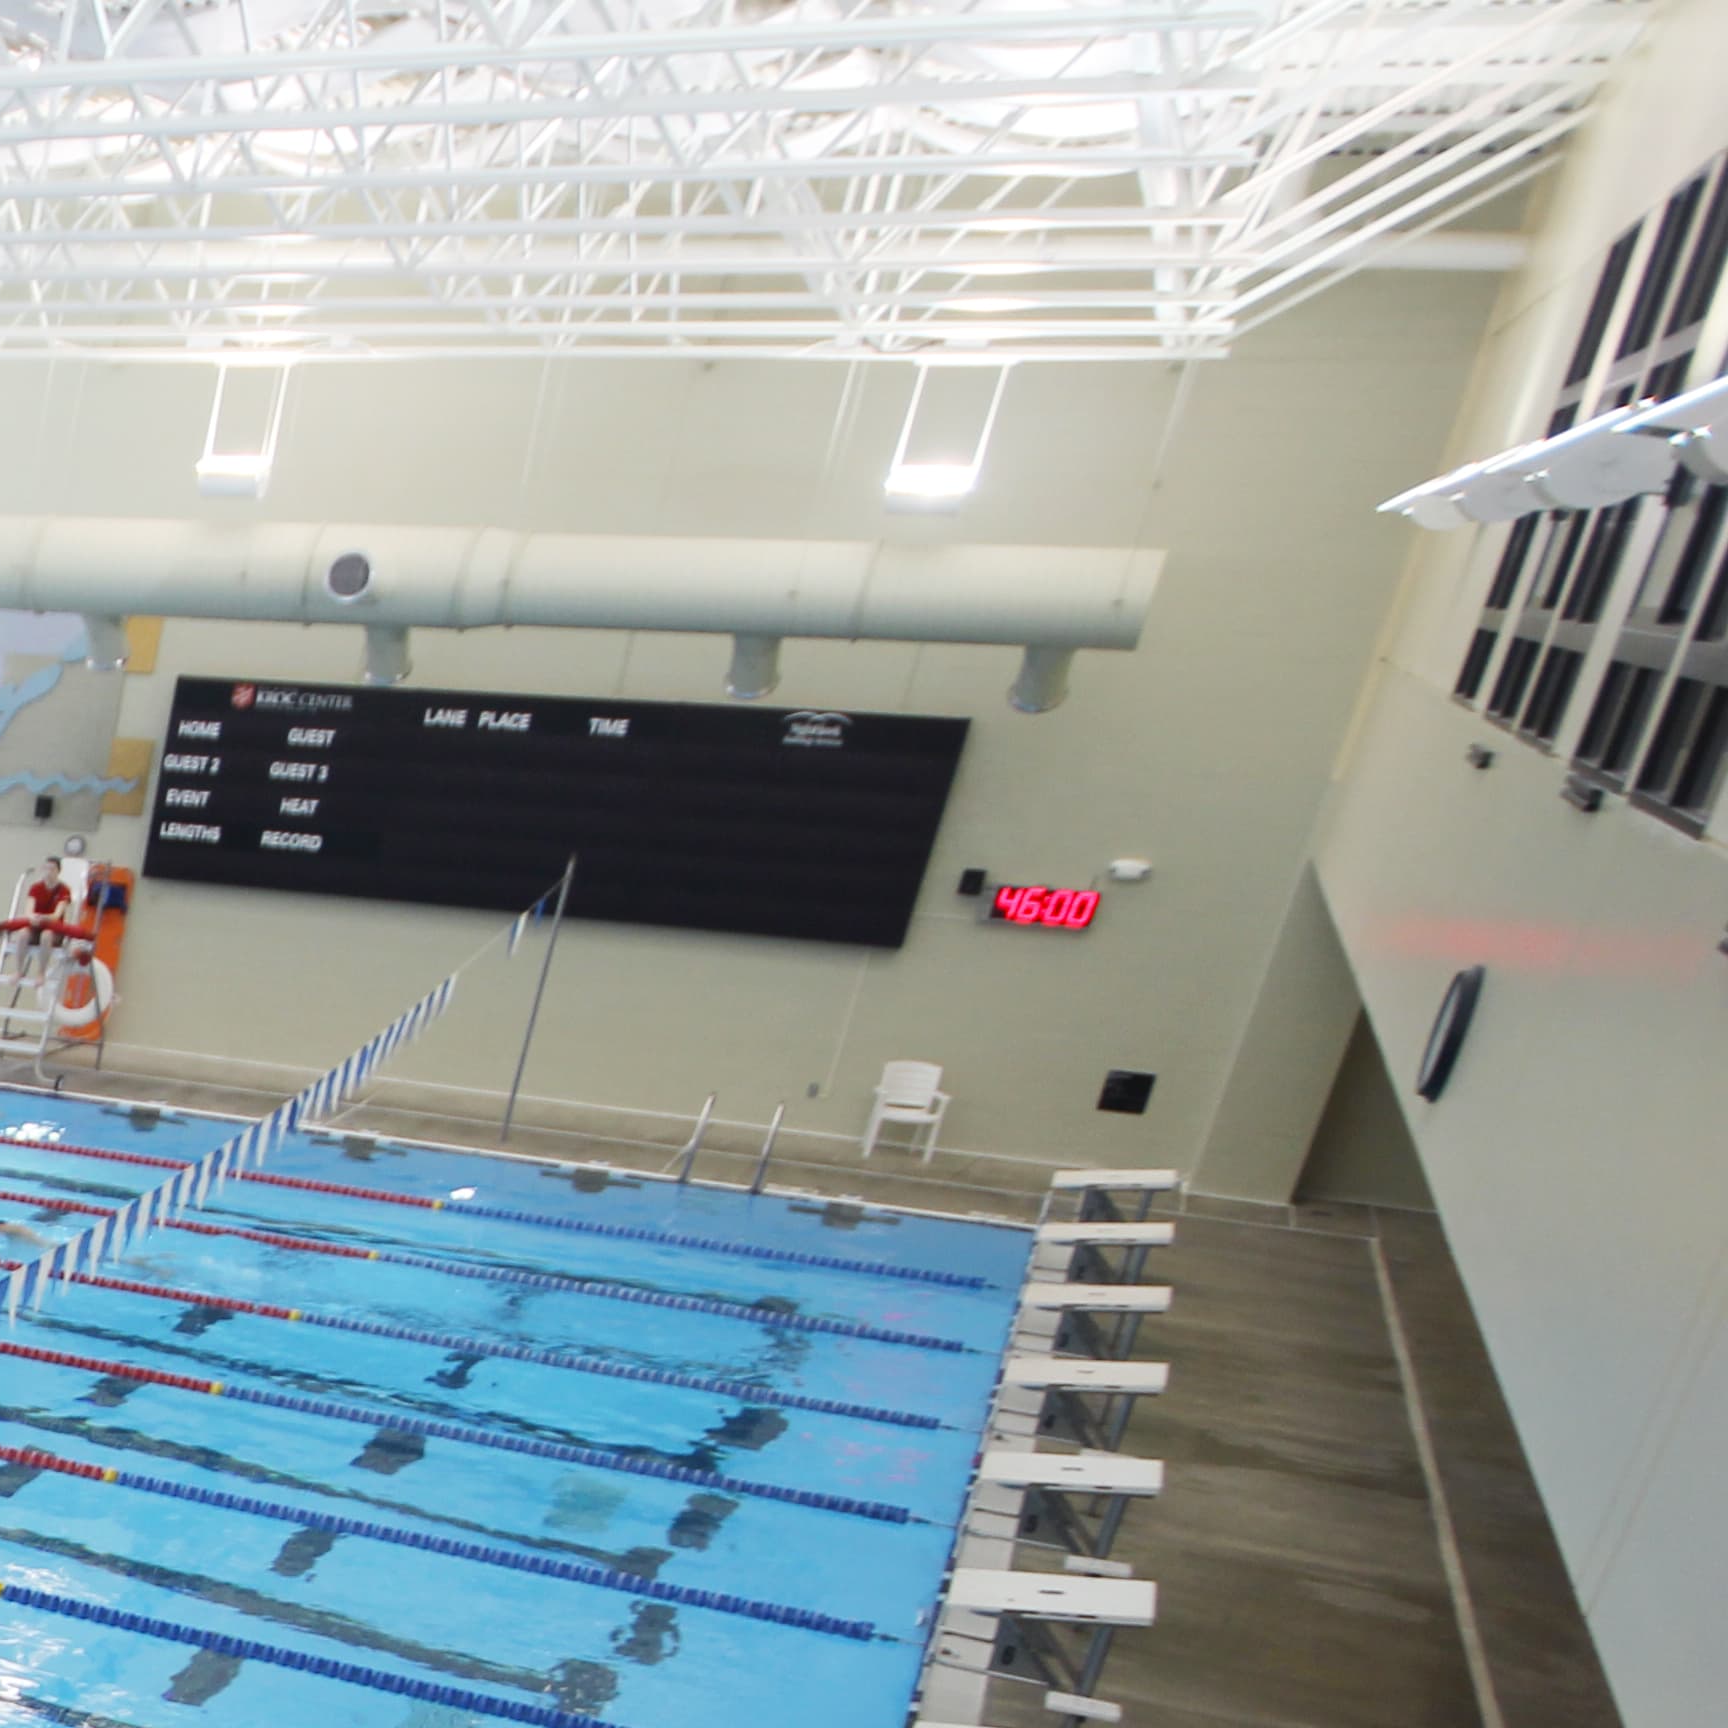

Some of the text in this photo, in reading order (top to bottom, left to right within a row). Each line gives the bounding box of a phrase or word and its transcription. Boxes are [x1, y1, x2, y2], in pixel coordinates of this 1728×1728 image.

[178, 720, 222, 740] HOME
[423, 707, 532, 732] LANE PLACE
[589, 716, 630, 738] TIME
[287, 727, 336, 748] GUEST
[163, 753, 221, 775] GUEST 2
[268, 761, 329, 783] GUEST 3
[165, 788, 211, 808] EVENT
[279, 797, 319, 816] HEAT
[159, 821, 222, 843] LENGTHS
[260, 830, 323, 852] RECORD
[997, 886, 1099, 928] 46:00
